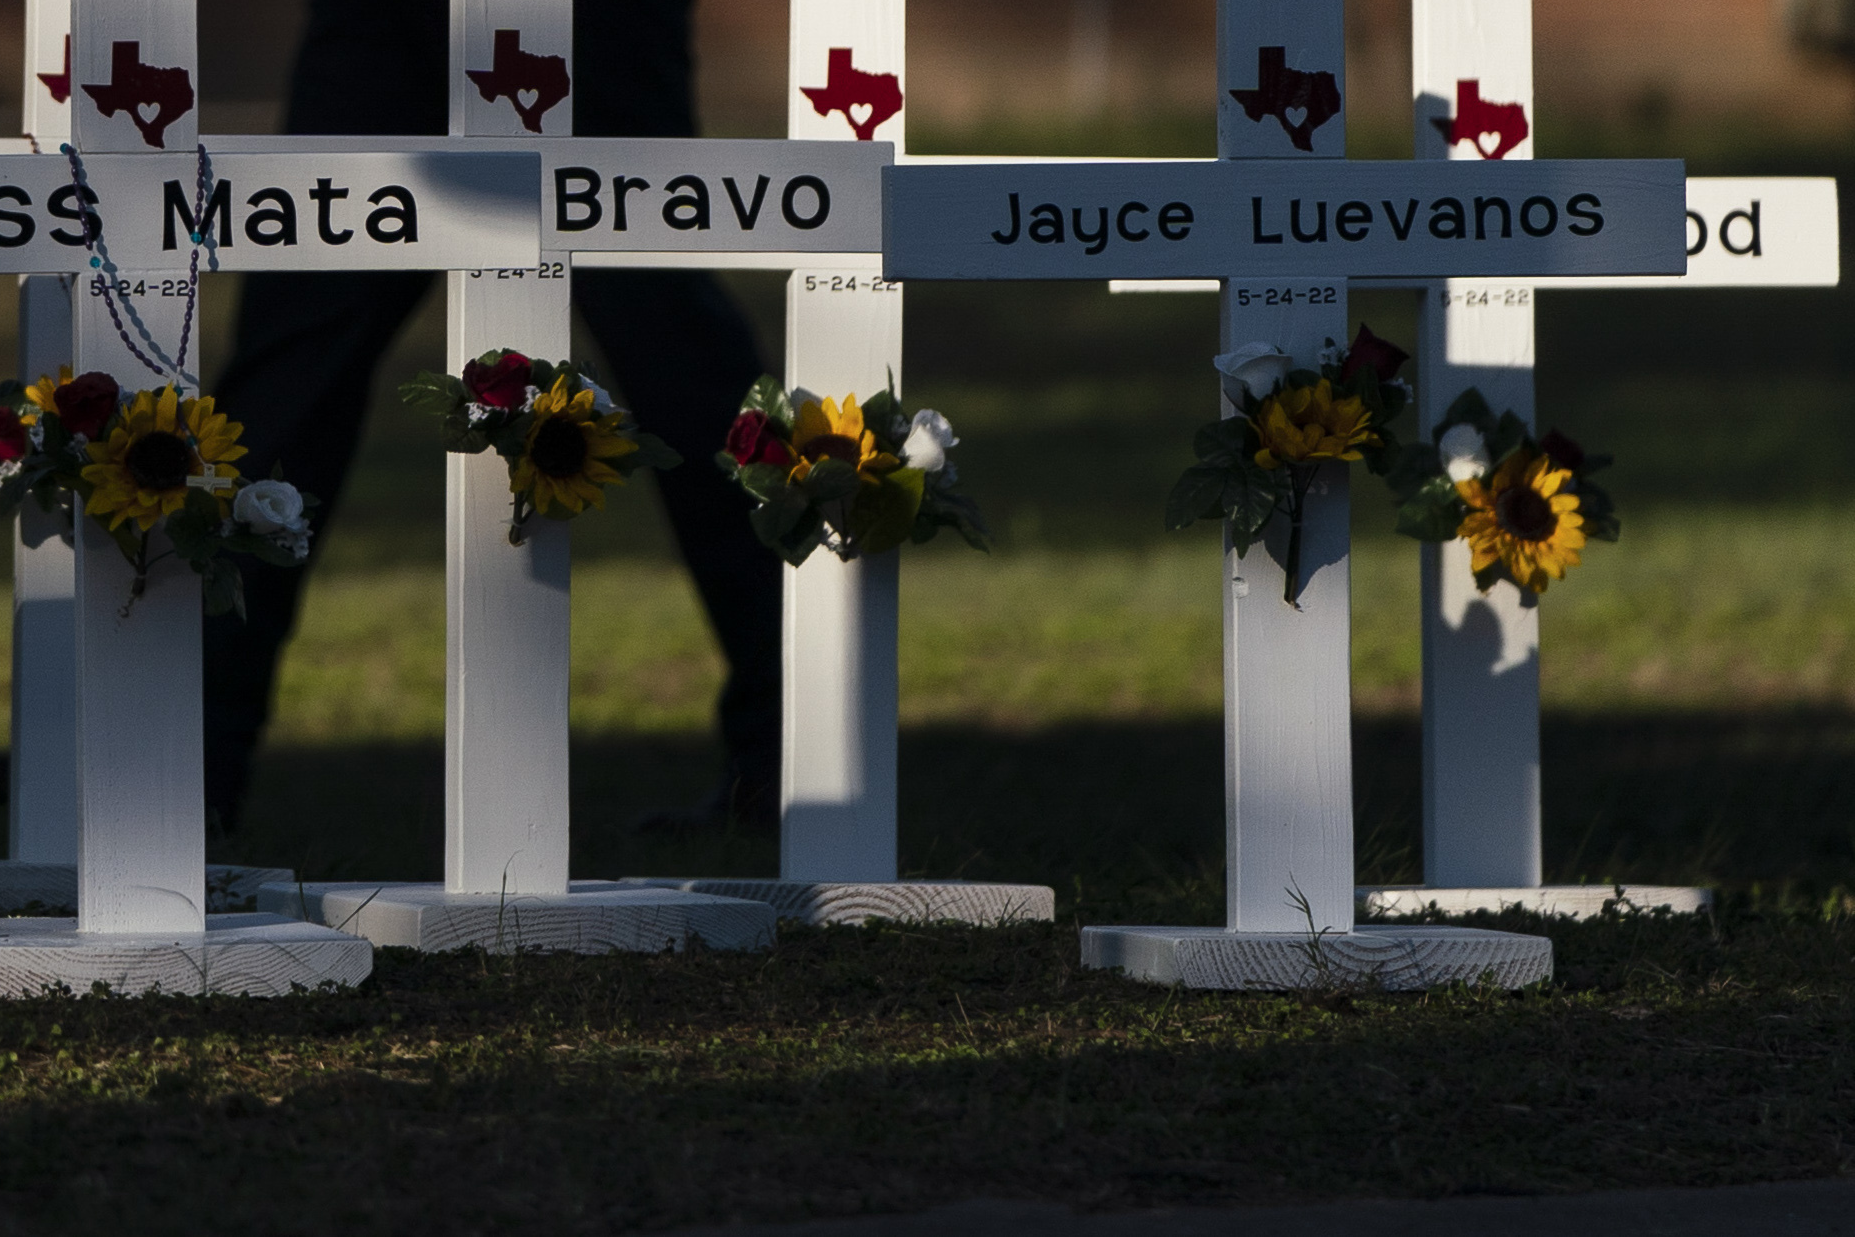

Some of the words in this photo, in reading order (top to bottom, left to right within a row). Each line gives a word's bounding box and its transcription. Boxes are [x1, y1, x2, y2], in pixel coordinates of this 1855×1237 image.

[162, 178, 418, 251] Mata
[554, 166, 831, 232] Bravo
[991, 192, 1195, 255] Jayce
[1251, 193, 1604, 245] Luevanos
[90, 279, 190, 297] 5-24-22
[1237, 286, 1337, 307] 5-24-22
